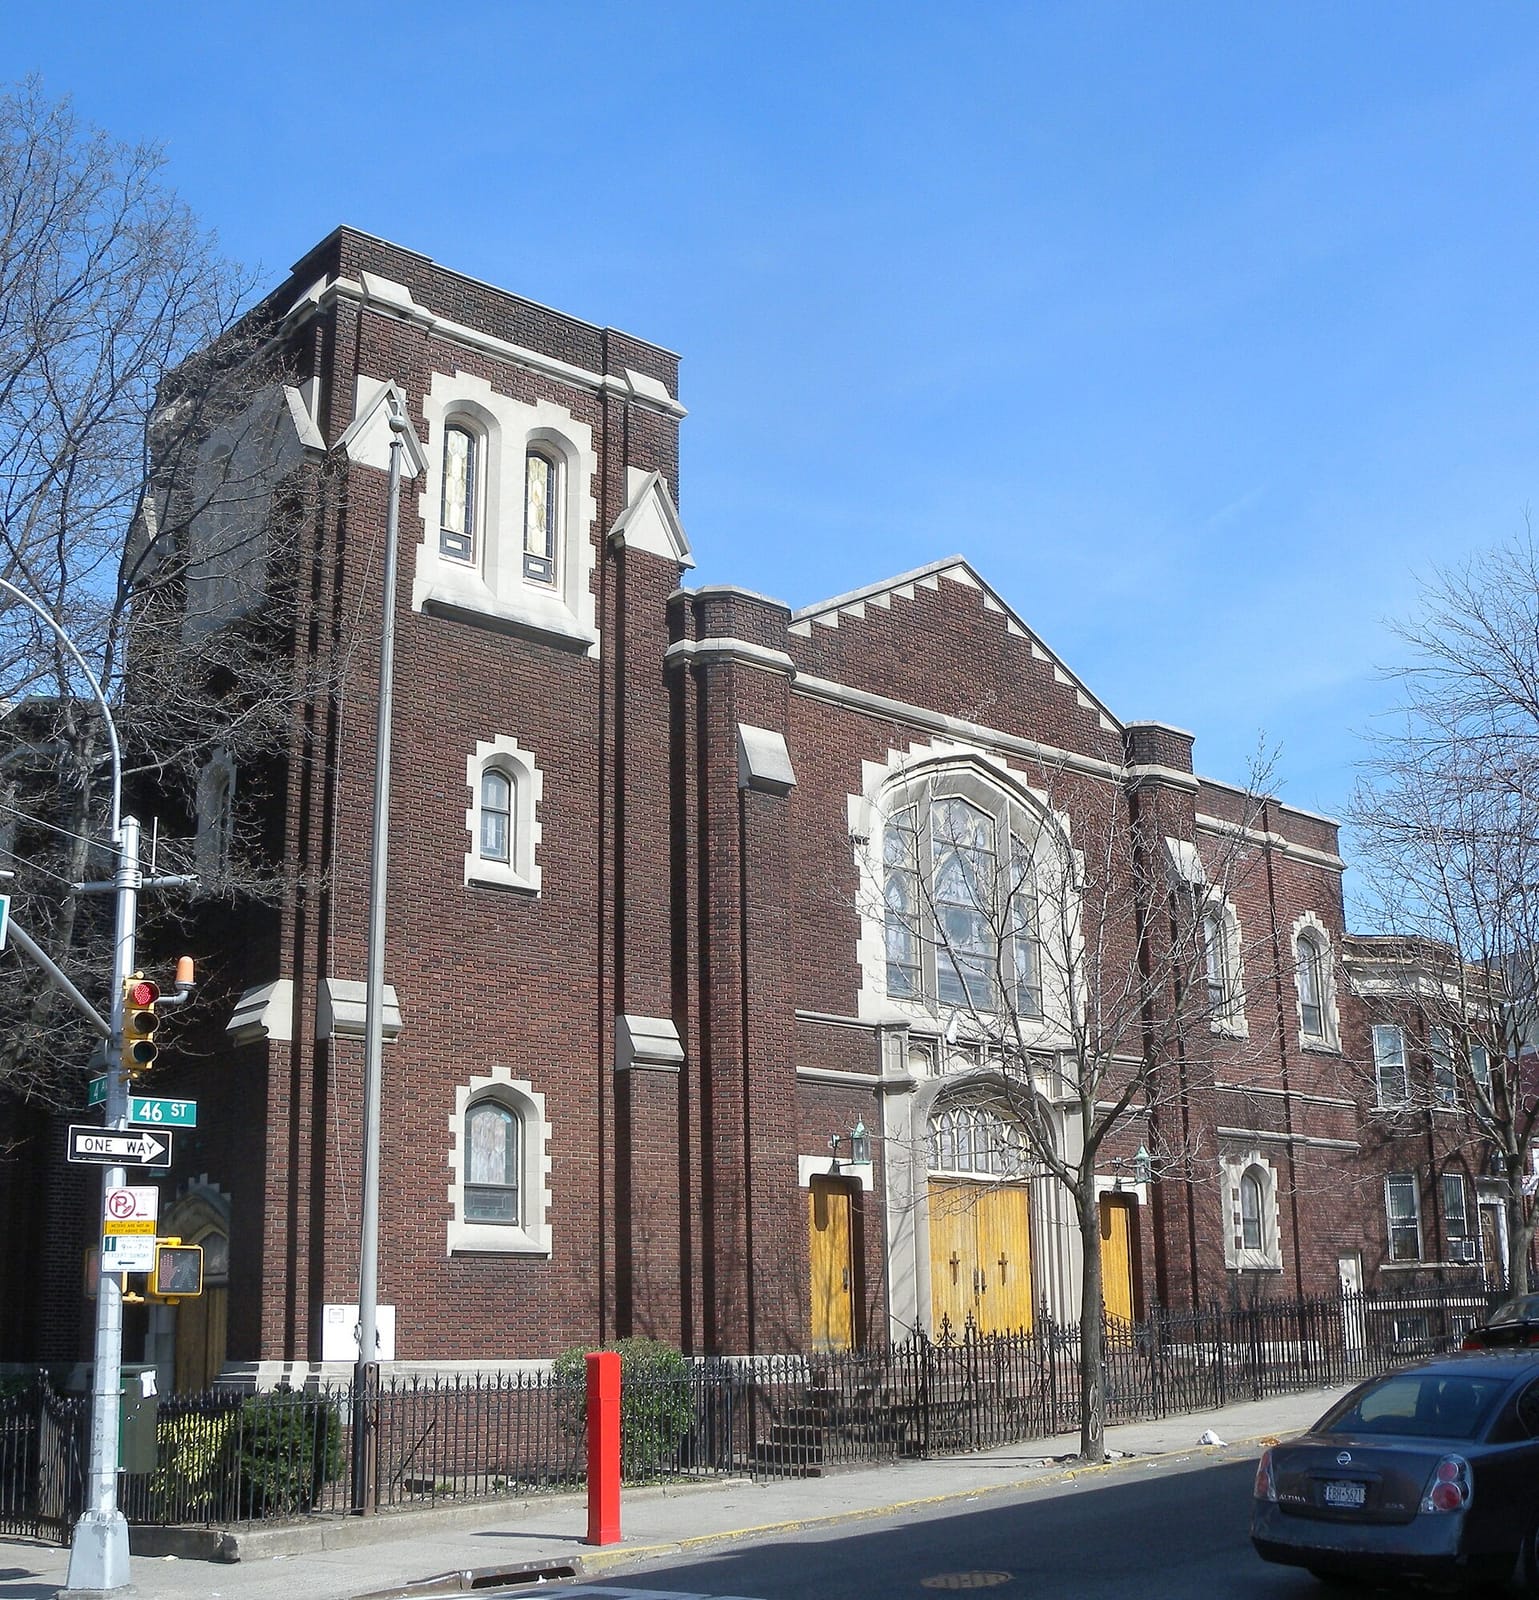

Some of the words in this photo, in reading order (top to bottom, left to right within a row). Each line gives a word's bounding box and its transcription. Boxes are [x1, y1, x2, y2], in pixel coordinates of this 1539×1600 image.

[93, 1082, 99, 1100] 4
[139, 1101, 163, 1121] 46
[171, 1103, 188, 1117] ST
[84, 1138, 113, 1152] ONE
[126, 1141, 155, 1154] WAY
